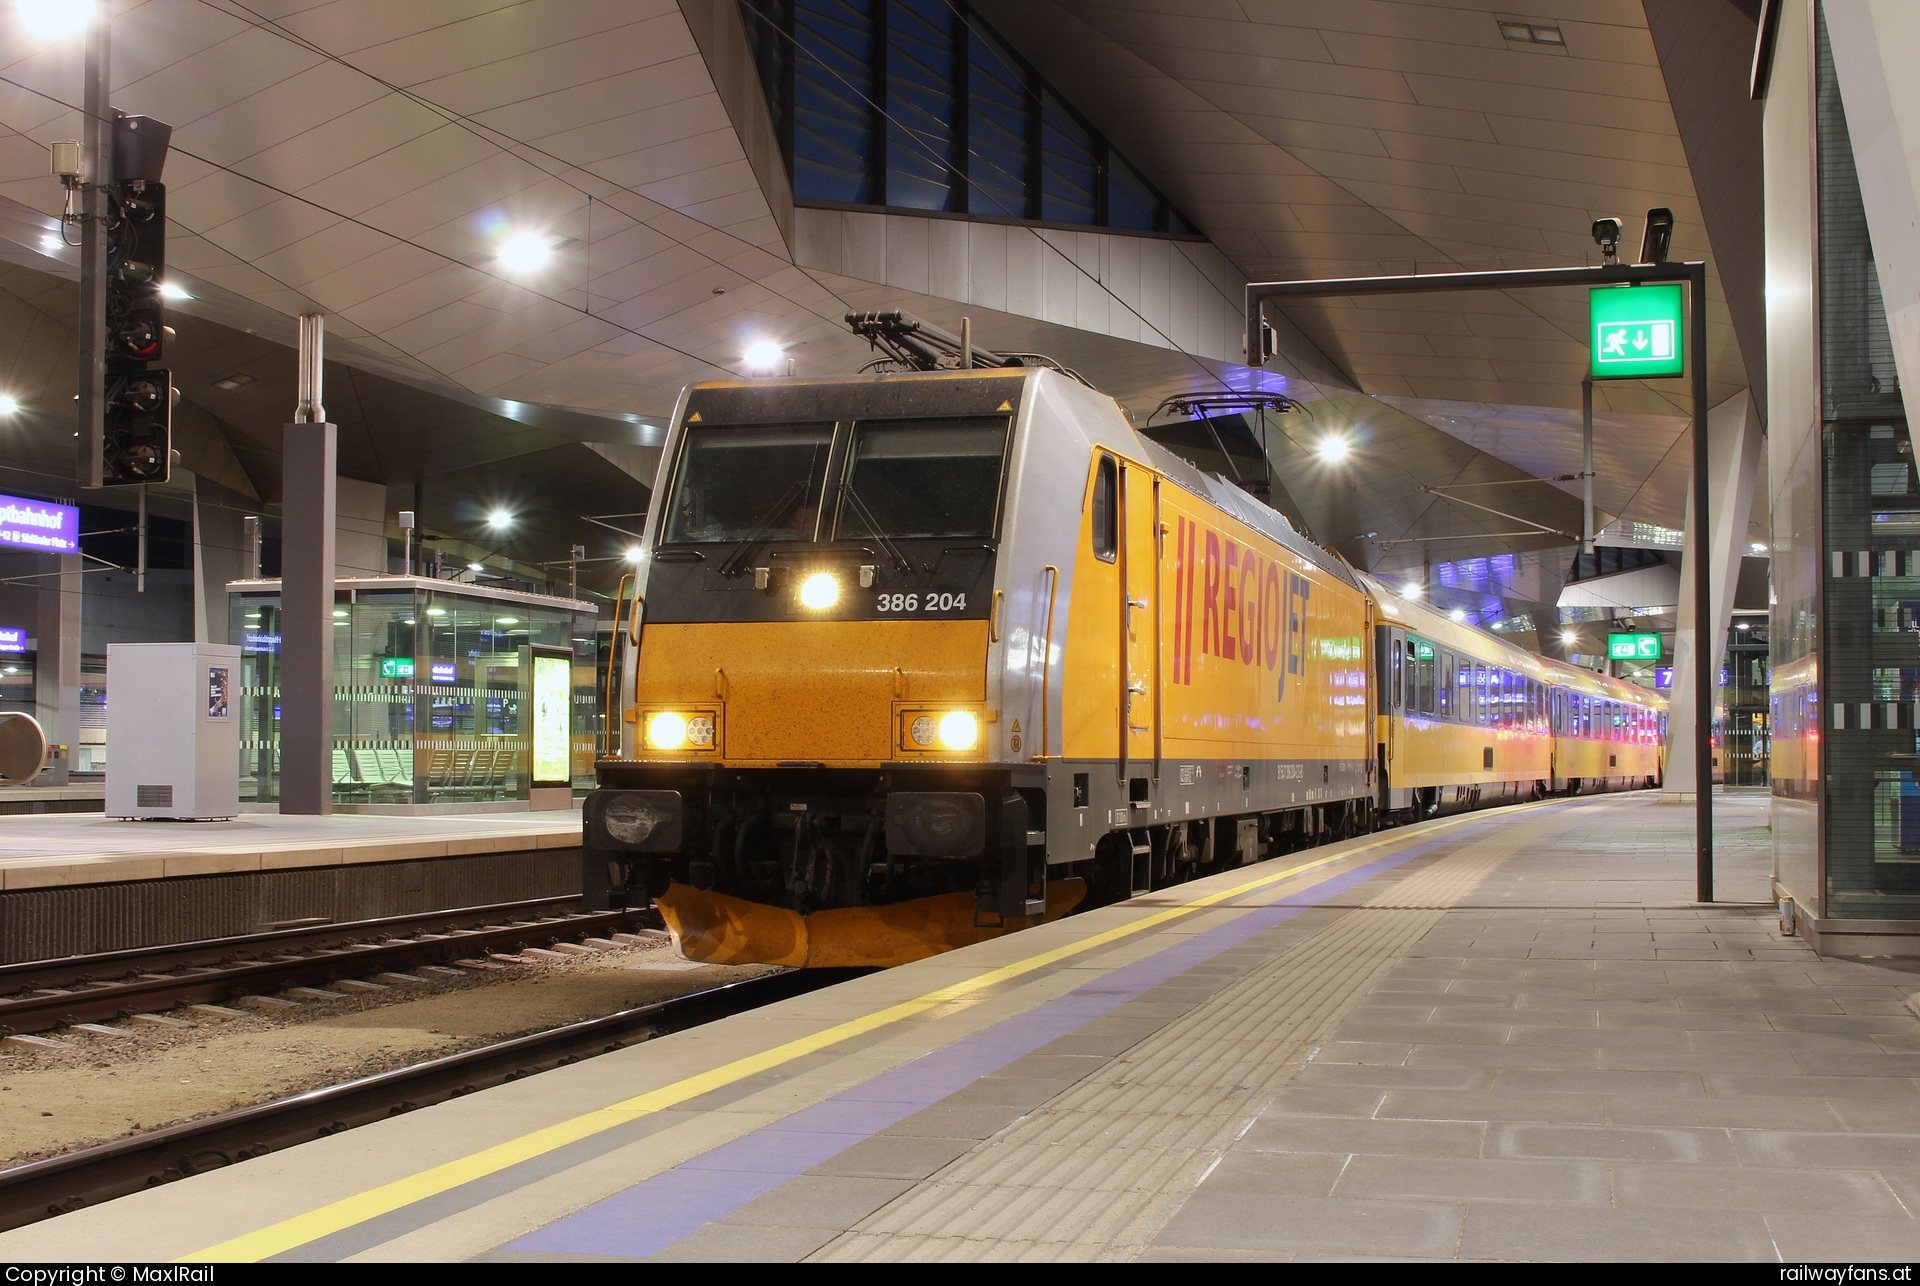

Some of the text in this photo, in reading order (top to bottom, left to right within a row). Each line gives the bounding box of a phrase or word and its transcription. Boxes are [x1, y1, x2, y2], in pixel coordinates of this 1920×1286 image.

[877, 592, 967, 612] 386 204
[1203, 529, 1310, 703] REGIOJET
[1662, 671, 1673, 685] 7
[502, 698, 509, 708] P
